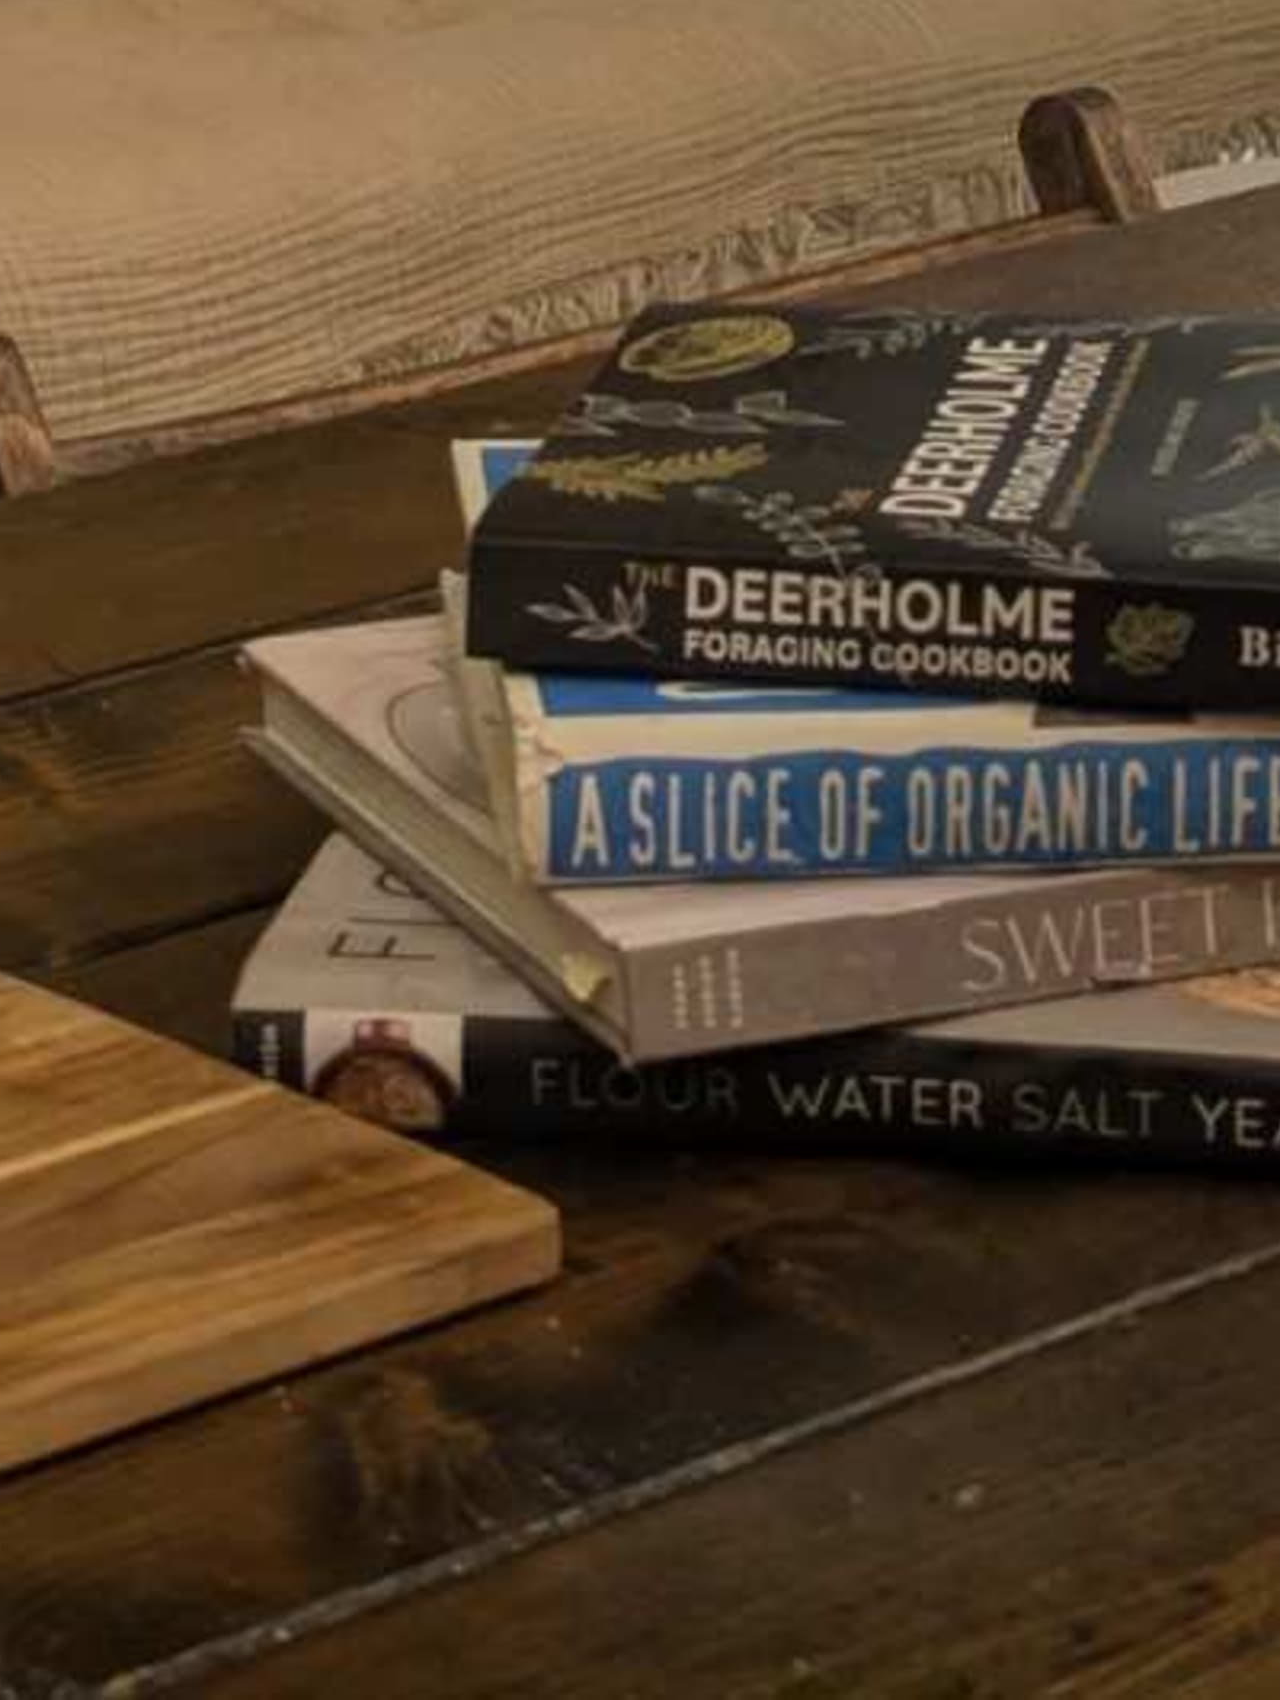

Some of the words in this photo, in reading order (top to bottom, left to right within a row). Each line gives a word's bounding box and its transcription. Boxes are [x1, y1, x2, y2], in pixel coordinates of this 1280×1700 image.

[879, 336, 1050, 518] DEERHOLME
[987, 435, 1070, 522] FORAGING
[1031, 341, 1114, 437] COOKBOOK
[626, 559, 675, 589] THE
[684, 564, 1076, 643] DEERHOLME
[683, 631, 862, 672] FORAGING
[869, 638, 1072, 684] COOKBOOK
[571, 774, 609, 870] A
[627, 769, 801, 869] SLICE
[818, 765, 886, 863] OF
[906, 757, 1148, 857] ORGANIC
[961, 884, 1234, 993] SWEET
[531, 1057, 741, 1119] FLOUR
[766, 1069, 985, 1130] WATER
[1011, 1083, 1163, 1140] SALT
